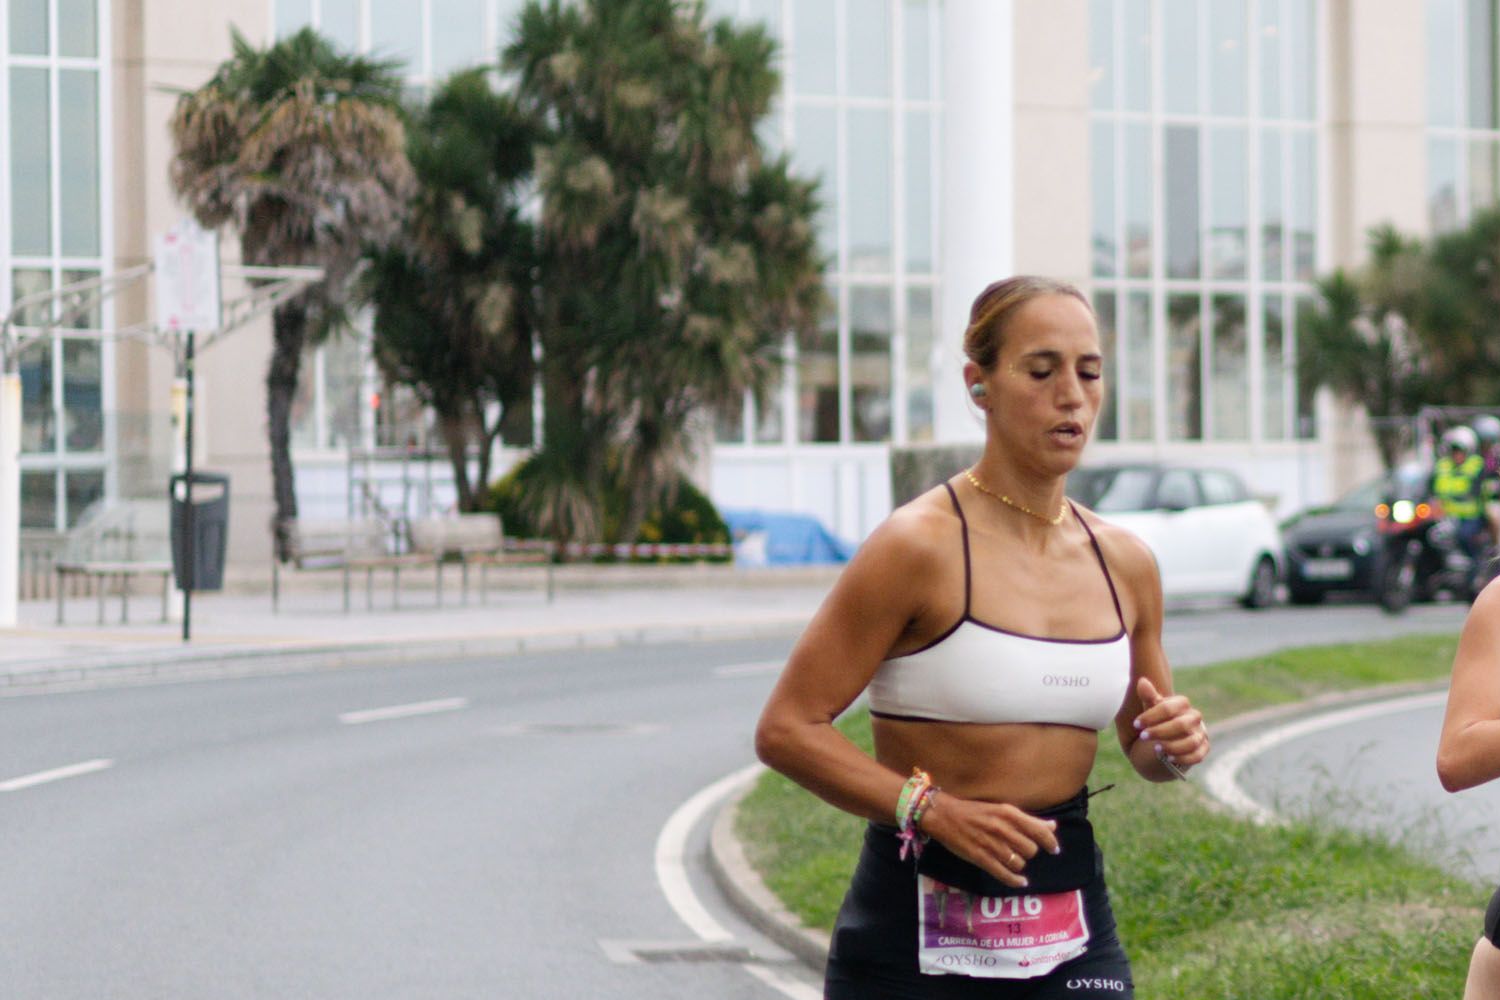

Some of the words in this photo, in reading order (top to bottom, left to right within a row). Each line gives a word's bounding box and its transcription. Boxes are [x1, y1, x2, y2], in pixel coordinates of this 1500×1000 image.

[1042, 674, 1090, 687] OYSHO
[980, 895, 1043, 919] 016
[1007, 922, 1021, 934] 13
[938, 935, 979, 947] CARRERA
[980, 937, 992, 948] DE
[993, 937, 1006, 948] LA
[1006, 934, 1035, 947] MUJER
[941, 953, 998, 968] OYSHO
[1065, 977, 1125, 993] OYSHO
